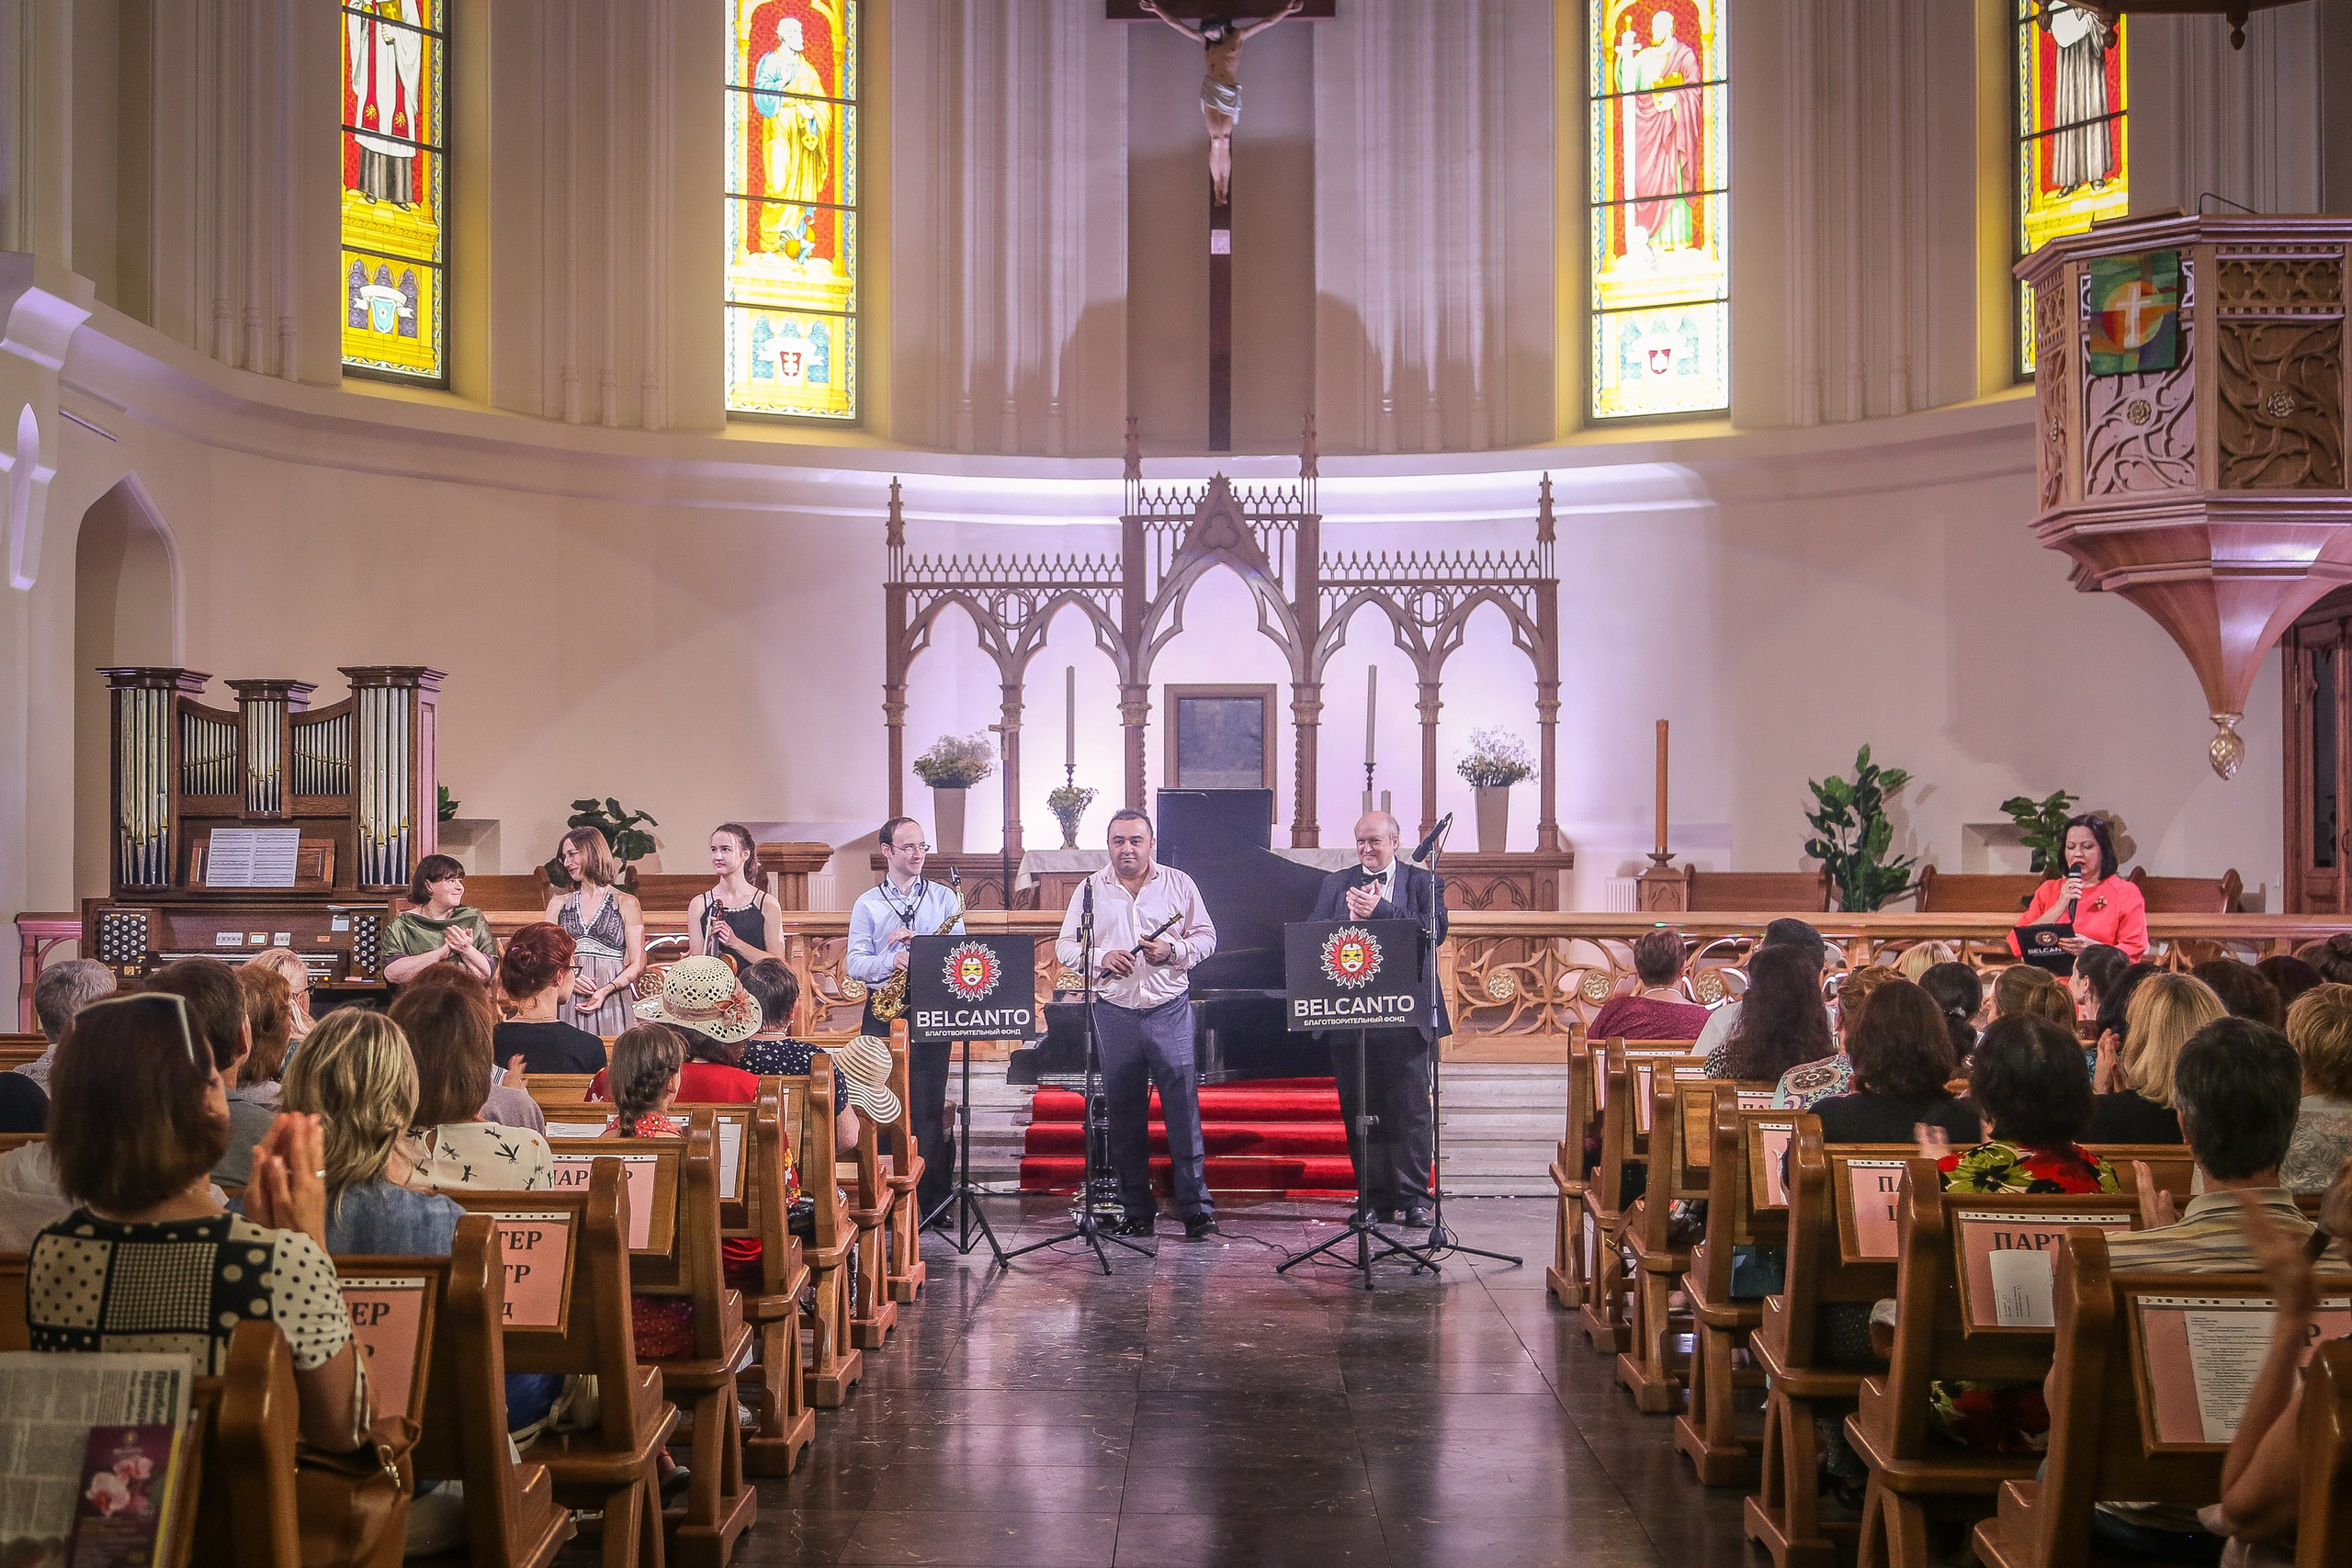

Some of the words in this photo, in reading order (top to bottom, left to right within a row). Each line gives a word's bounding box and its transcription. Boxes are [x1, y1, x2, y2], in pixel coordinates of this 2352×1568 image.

[2028, 947, 2063, 955] BELCAN
[1294, 995, 1415, 1017] BELCANTO
[916, 1009, 1031, 1028] BELCANTO
[1304, 1015, 1384, 1026] БЛАГОТВОРИТЕЛЬНЫЙ
[1384, 1015, 1406, 1024] ФОНД
[925, 1028, 1001, 1037] БЛАГОТВОРИТЕЛЬНЫЙ
[1001, 1028, 1022, 1036] ФОНД
[499, 1230, 543, 1250] ТЕР
[1994, 1232, 2065, 1251] ПАРТ
